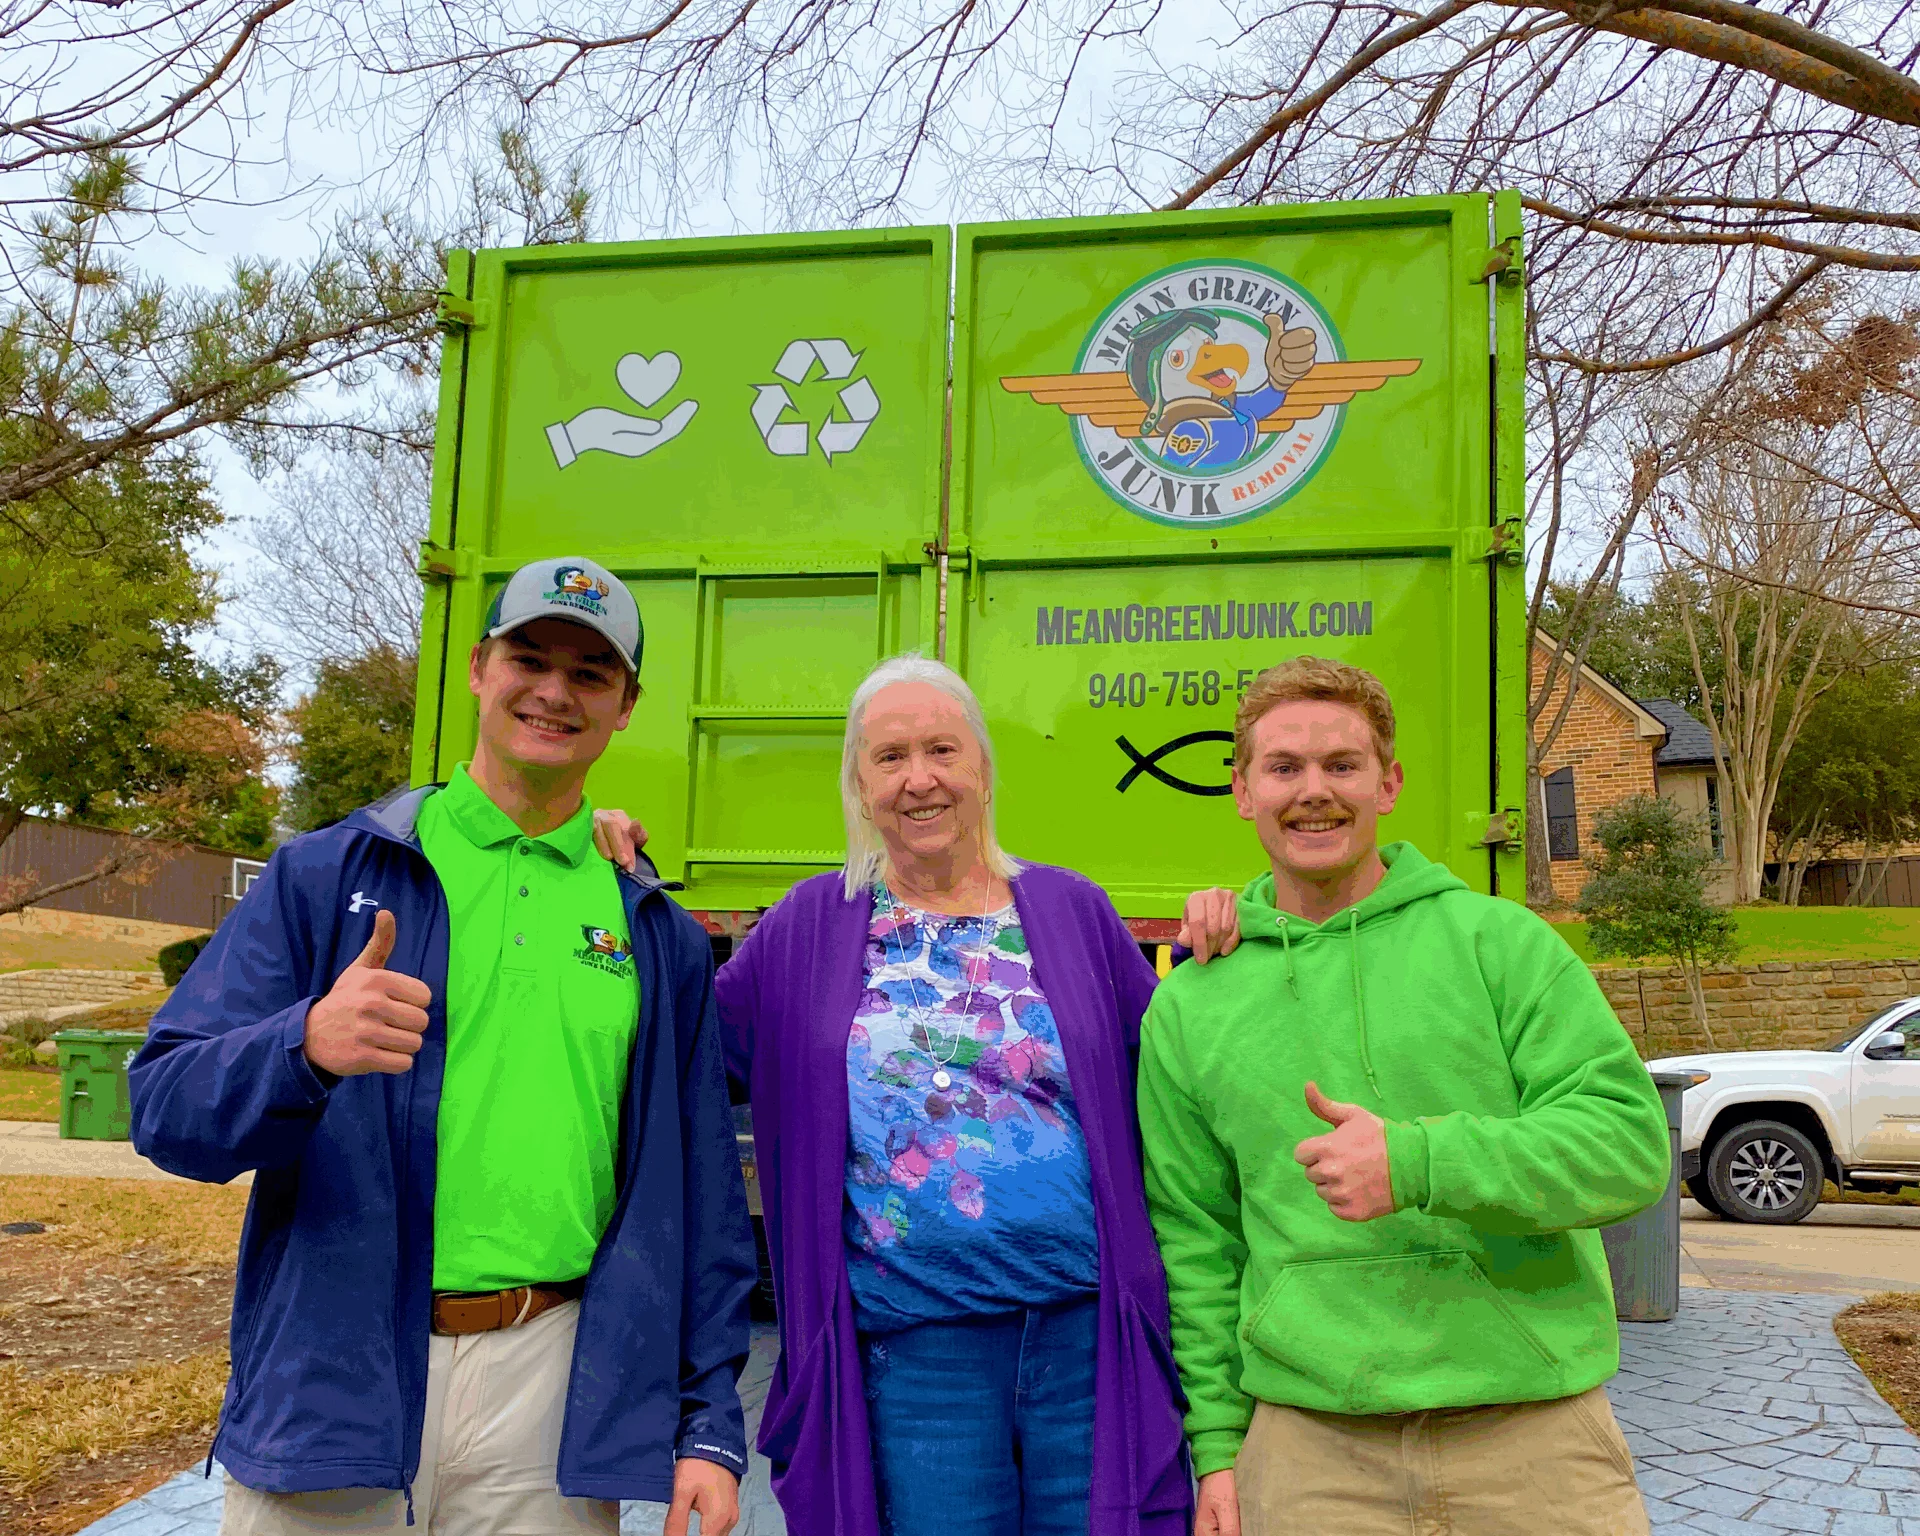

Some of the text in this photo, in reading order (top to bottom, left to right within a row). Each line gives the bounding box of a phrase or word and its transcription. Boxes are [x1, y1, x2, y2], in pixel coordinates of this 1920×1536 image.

[1096, 276, 1301, 366] MEAN GREEN
[1097, 431, 1314, 516] JUNK REMOVAL
[1089, 668, 1269, 708] 940-758-5
[694, 1443, 720, 1453] UNDER
